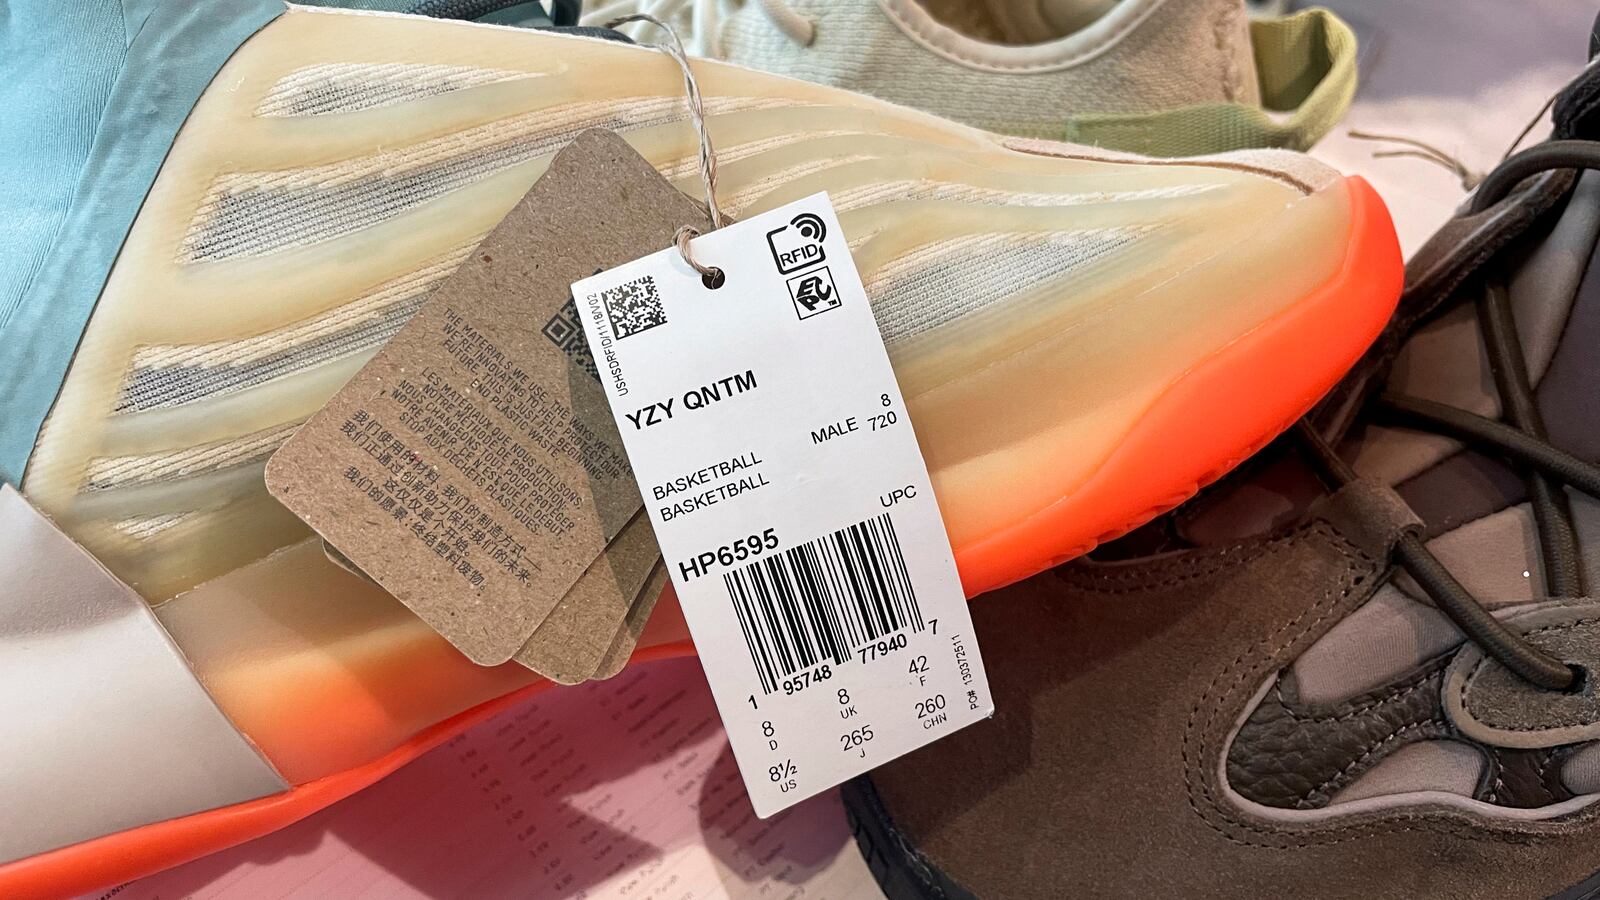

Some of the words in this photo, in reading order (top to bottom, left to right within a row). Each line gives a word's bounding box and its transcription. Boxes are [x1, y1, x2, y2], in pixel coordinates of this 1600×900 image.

[780, 244, 818, 266] RFID
[587, 293, 628, 396] USHSDRFID/1118/V02
[441, 338, 483, 375] FUTURE.
[481, 372, 505, 395] THIS
[502, 391, 516, 404] IS
[513, 400, 538, 424] JUST
[536, 420, 558, 440] THE
[441, 322, 475, 354] WE'RE
[471, 349, 527, 398] INNOVATING
[525, 395, 540, 409] TO
[537, 405, 564, 431] HELP
[561, 426, 602, 463] PROTECT
[599, 458, 621, 479] OUR
[442, 307, 463, 327] THE
[460, 323, 514, 371] MATERIALS
[511, 366, 530, 385] WE
[549, 400, 570, 420] THE
[567, 416, 595, 442] WAYS
[593, 438, 611, 455] WE
[469, 378, 491, 398] END
[489, 394, 529, 431] PLASTIC
[625, 398, 674, 430] YZY
[683, 370, 758, 410] QNTM
[880, 394, 892, 406] 8
[398, 410, 426, 435] STOP
[422, 431, 445, 452] AUX
[398, 378, 427, 405] NOUS
[424, 400, 481, 452] CHANGEONS
[479, 448, 505, 472] TOUT
[502, 467, 530, 493] POUR
[420, 366, 443, 387] LES
[489, 425, 512, 447] QUE
[509, 442, 537, 468] NOUS
[421, 382, 455, 413] NOTRE
[495, 445, 511, 461] DE
[810, 417, 858, 444] MALE
[867, 411, 897, 432] 720
[390, 387, 424, 418] NOTRE
[421, 414, 461, 450] AVENIR.
[458, 445, 474, 461] CE
[499, 481, 521, 502] QUE
[519, 497, 535, 513] LE
[652, 452, 762, 500] BASKETBALL
[660, 473, 770, 522] BASKETBALL
[880, 485, 916, 507] UPC
[679, 528, 779, 582] HP6595
[748, 694, 758, 710] 1
[783, 664, 832, 696] 95748
[858, 634, 907, 664] 77940
[928, 619, 938, 634] 7
[952, 634, 973, 686] 130372511
[762, 721, 774, 737] 8
[838, 688, 850, 704] 8
[909, 656, 930, 674] 42
[769, 740, 778, 750] D
[840, 706, 858, 719] UK
[920, 676, 926, 686] F
[840, 725, 874, 751] 265
[914, 694, 946, 718] 260
[966, 690, 980, 710] PO#
[780, 780, 797, 792] US
[860, 748, 866, 758] J
[924, 712, 947, 730] CHN
